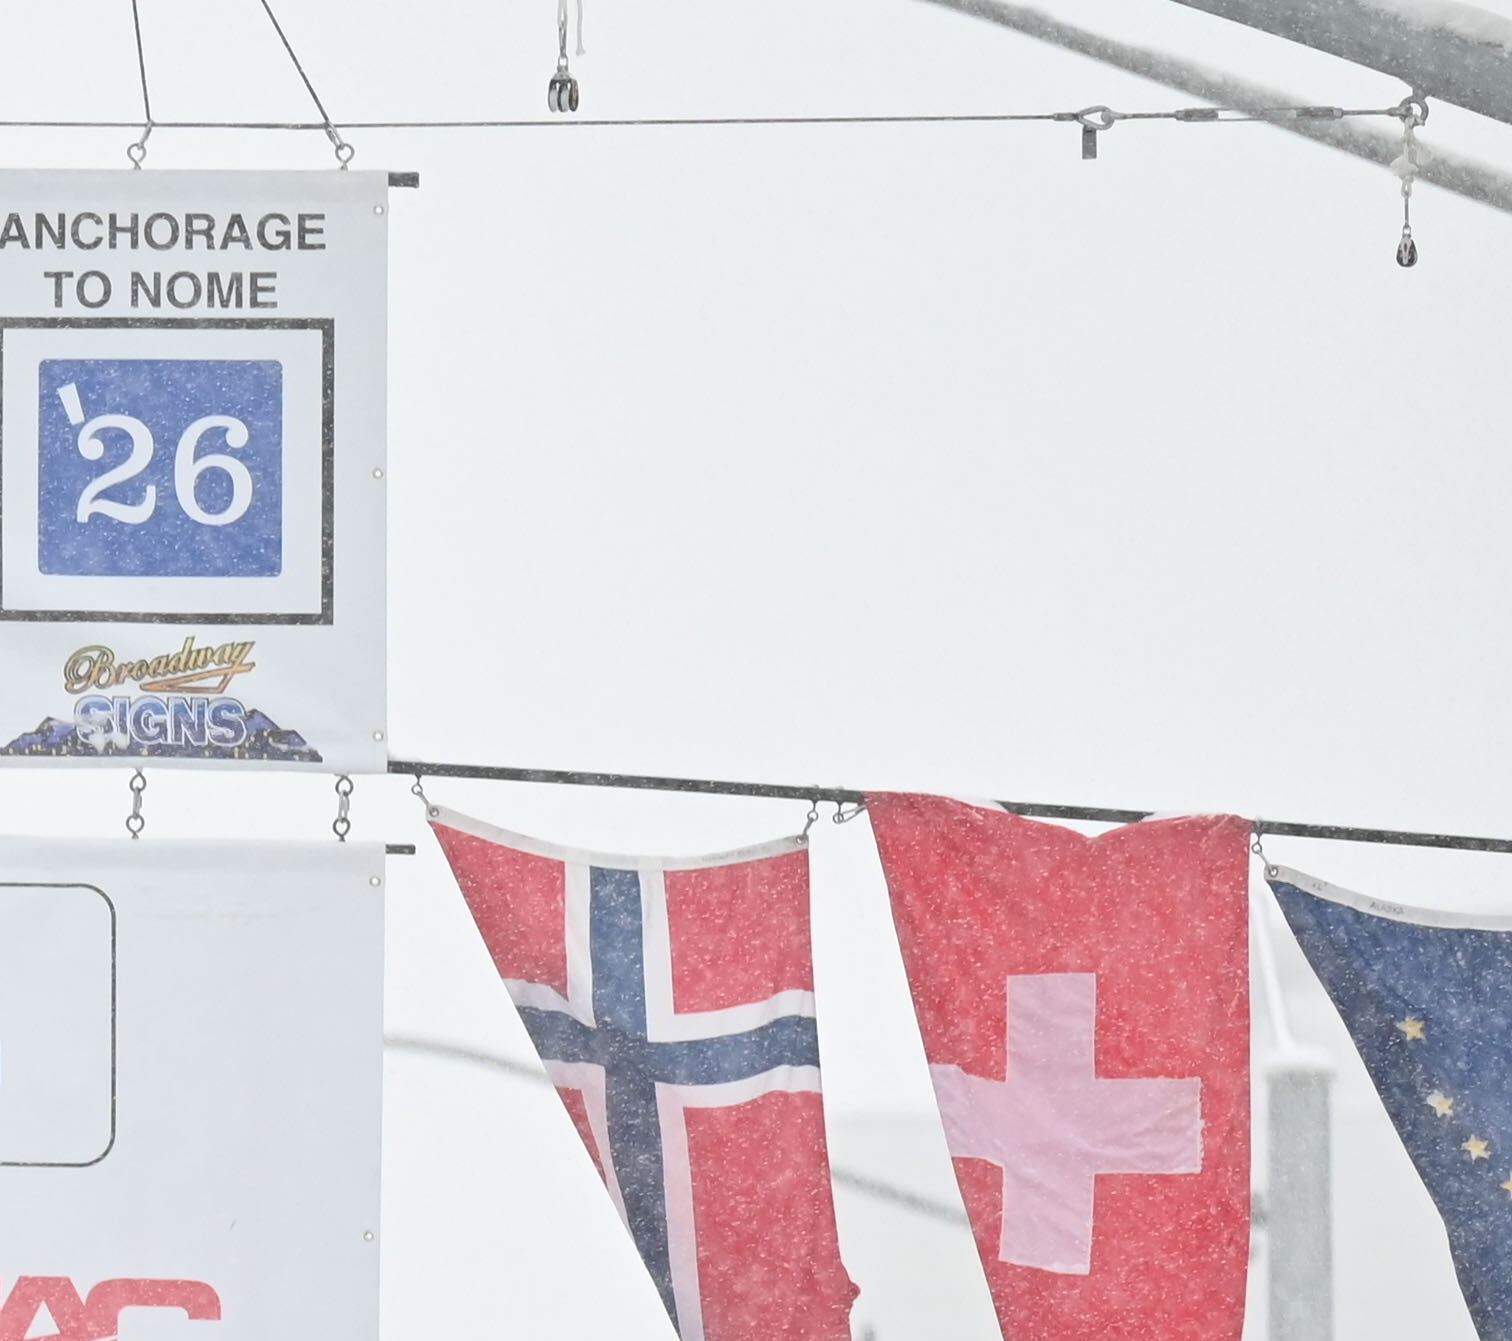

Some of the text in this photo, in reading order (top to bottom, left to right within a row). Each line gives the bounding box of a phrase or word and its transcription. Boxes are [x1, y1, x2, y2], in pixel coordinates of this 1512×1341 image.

[44, 271, 278, 309] TO NOME
[63, 635, 257, 695] Broadway
[74, 694, 249, 749] SIGNS
